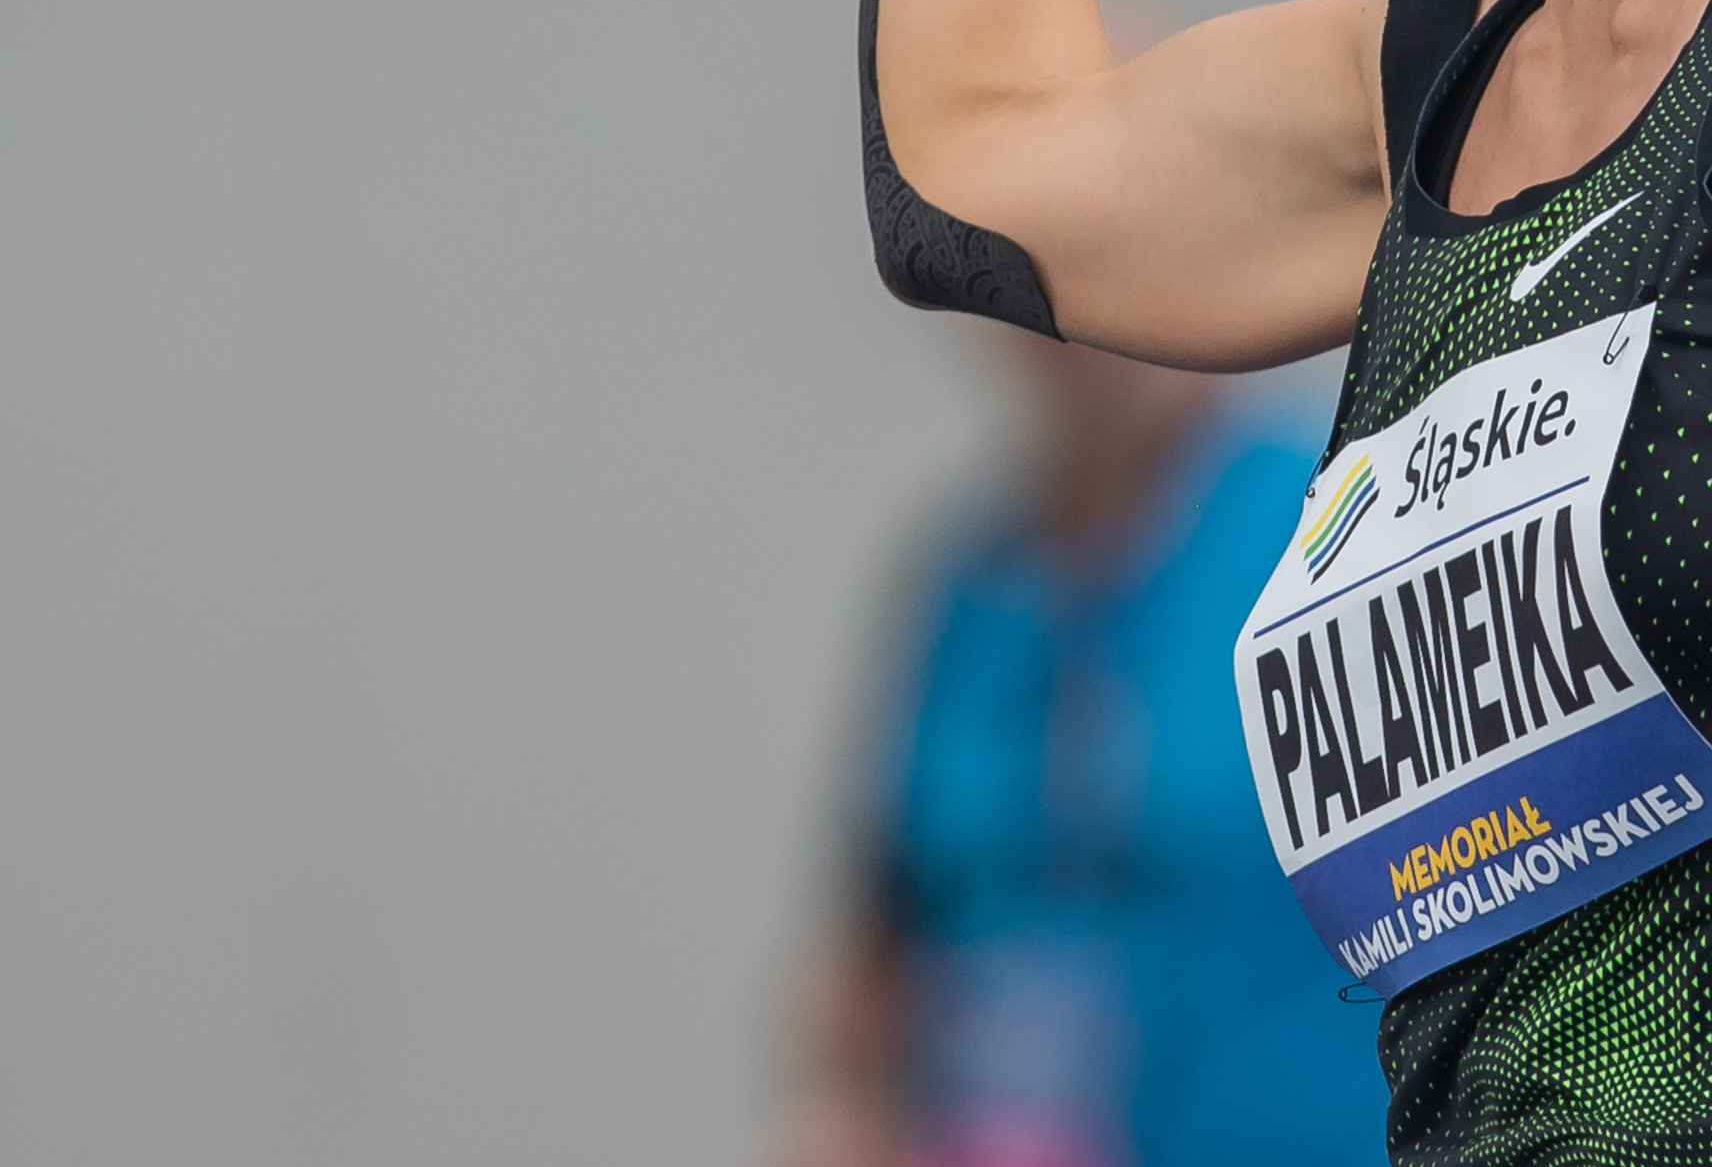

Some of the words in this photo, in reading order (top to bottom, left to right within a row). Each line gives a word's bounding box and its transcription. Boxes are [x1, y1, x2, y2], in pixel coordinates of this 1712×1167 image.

[1394, 378, 1576, 518] Śląskie.
[1256, 504, 1634, 851] PALAMEIKA
[1338, 909, 1412, 979] KAMILI
[1412, 773, 1704, 942] SKOLIMOWSKIEJ
[1388, 796, 1552, 901] MEMORIAŁ
